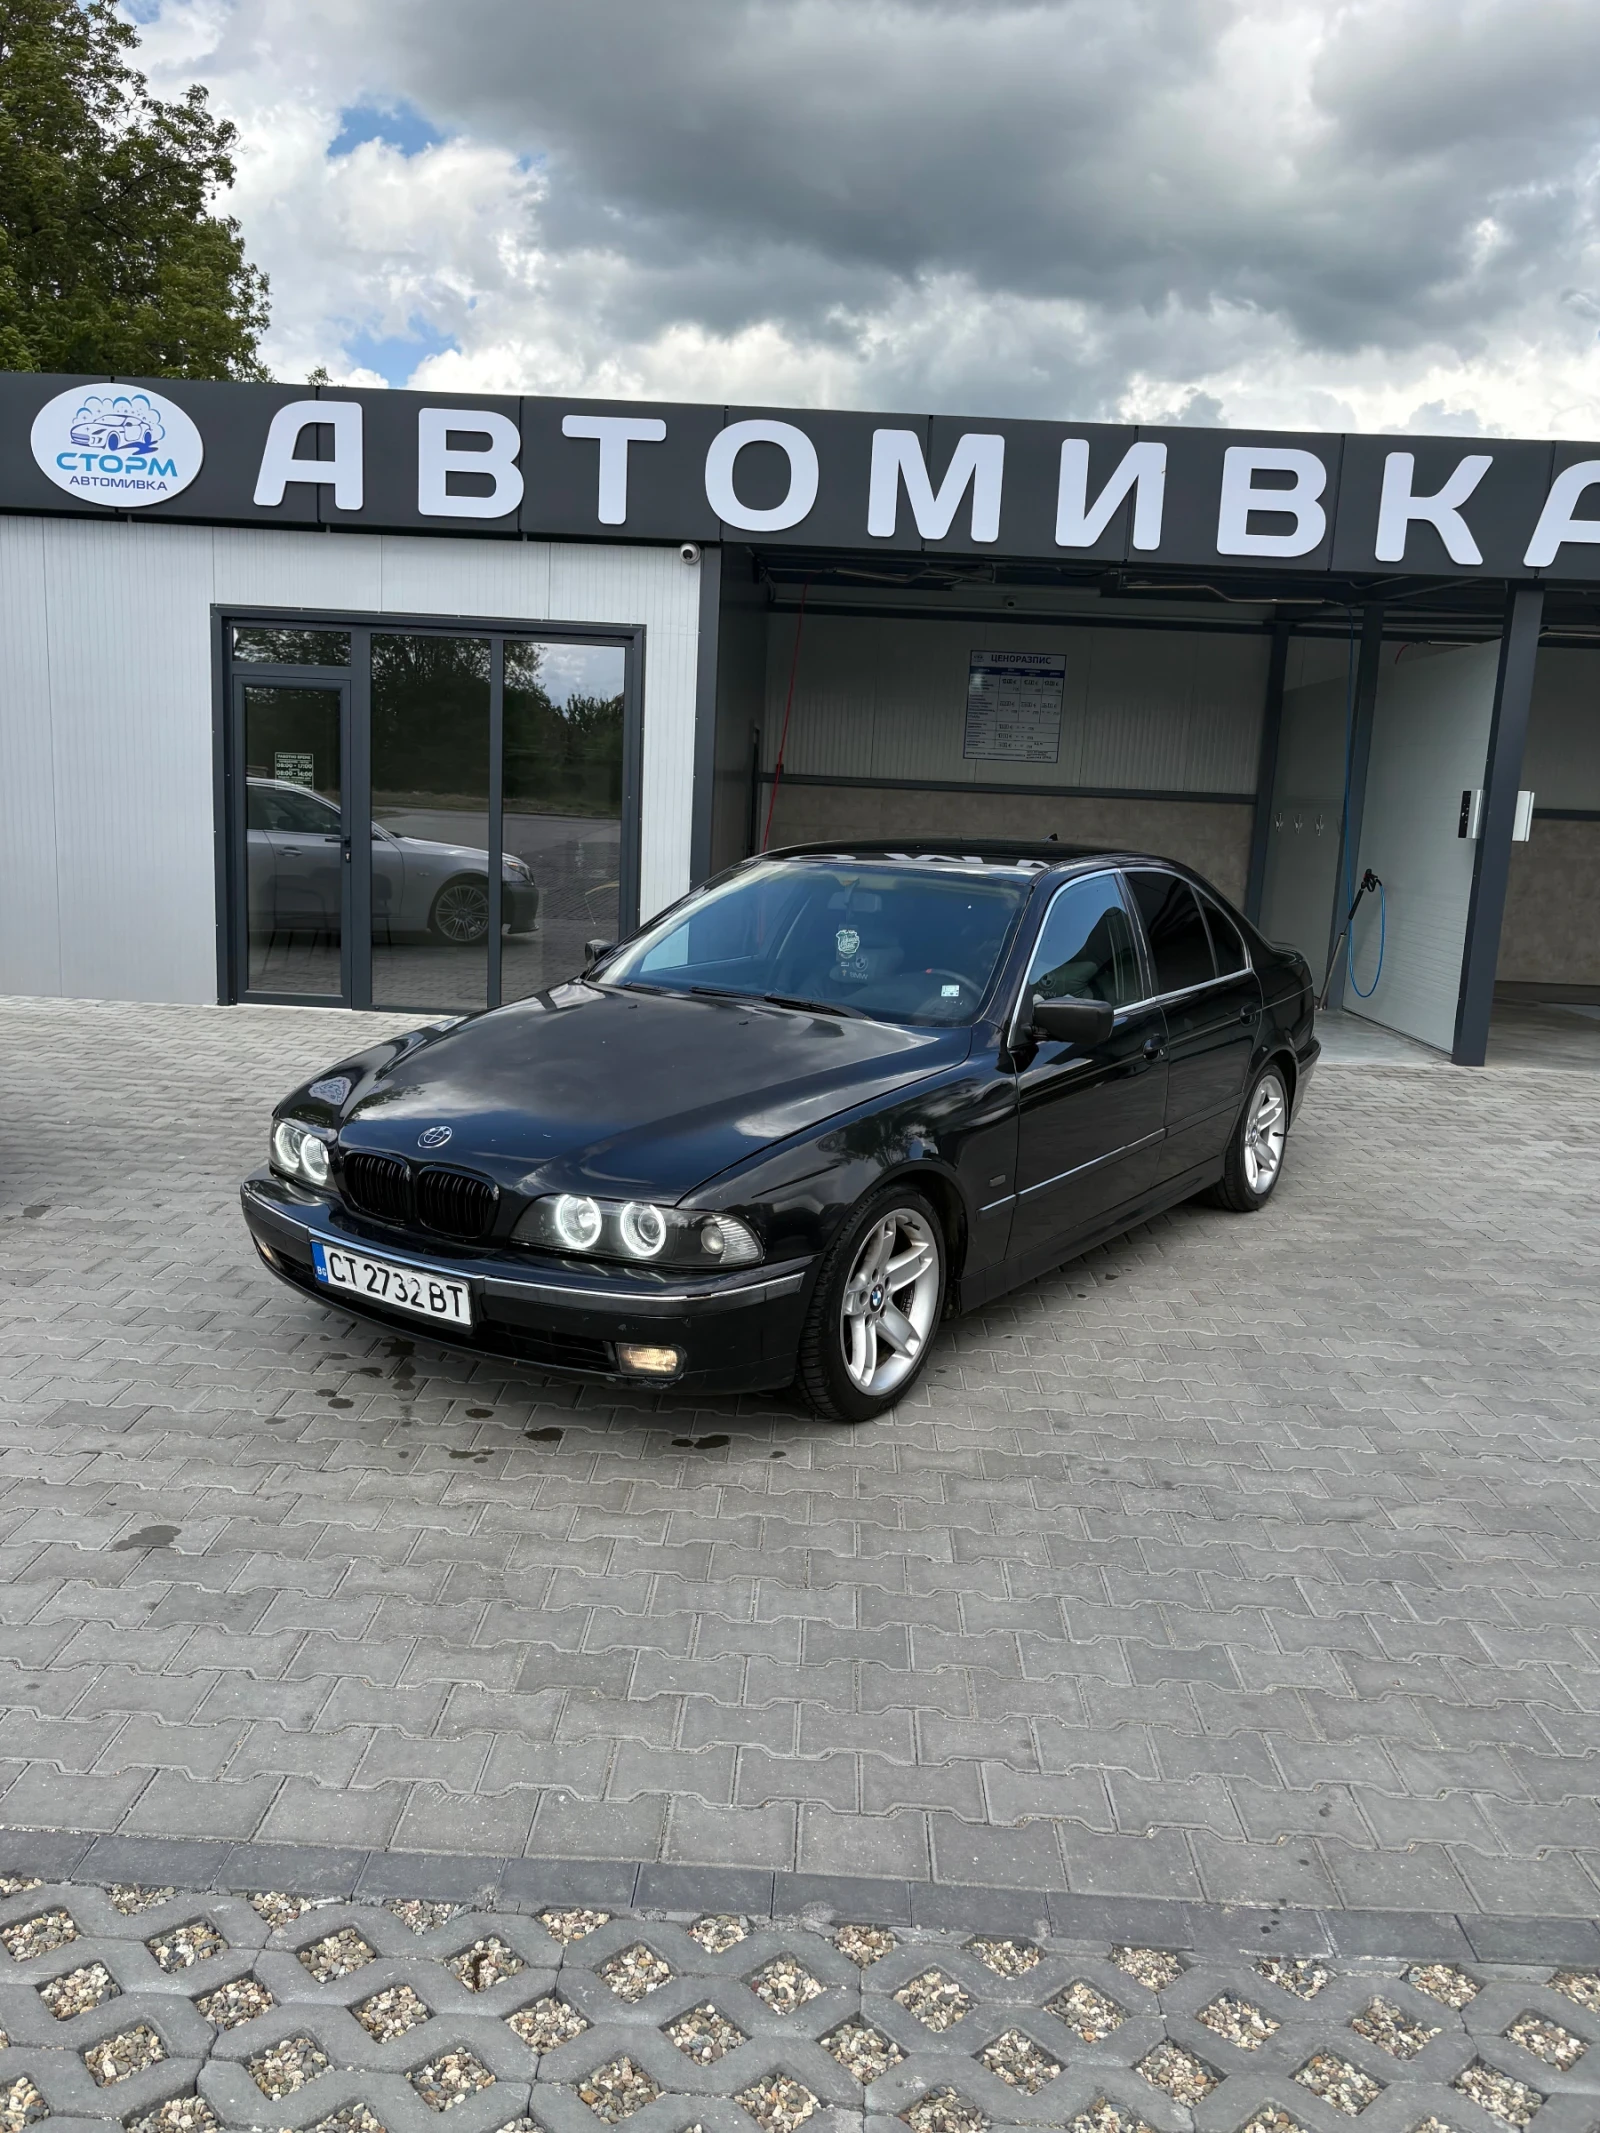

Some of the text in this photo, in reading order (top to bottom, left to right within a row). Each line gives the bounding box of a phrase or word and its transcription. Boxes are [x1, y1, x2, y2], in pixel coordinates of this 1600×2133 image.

[56, 452, 178, 477] СТОРМ
[69, 475, 168, 491] АВТОМИВКА
[253, 399, 1600, 568] АВТОМИВКА
[991, 654, 1052, 665] ЦЕНОРАЗПИС
[317, 1267, 327, 1276] BG
